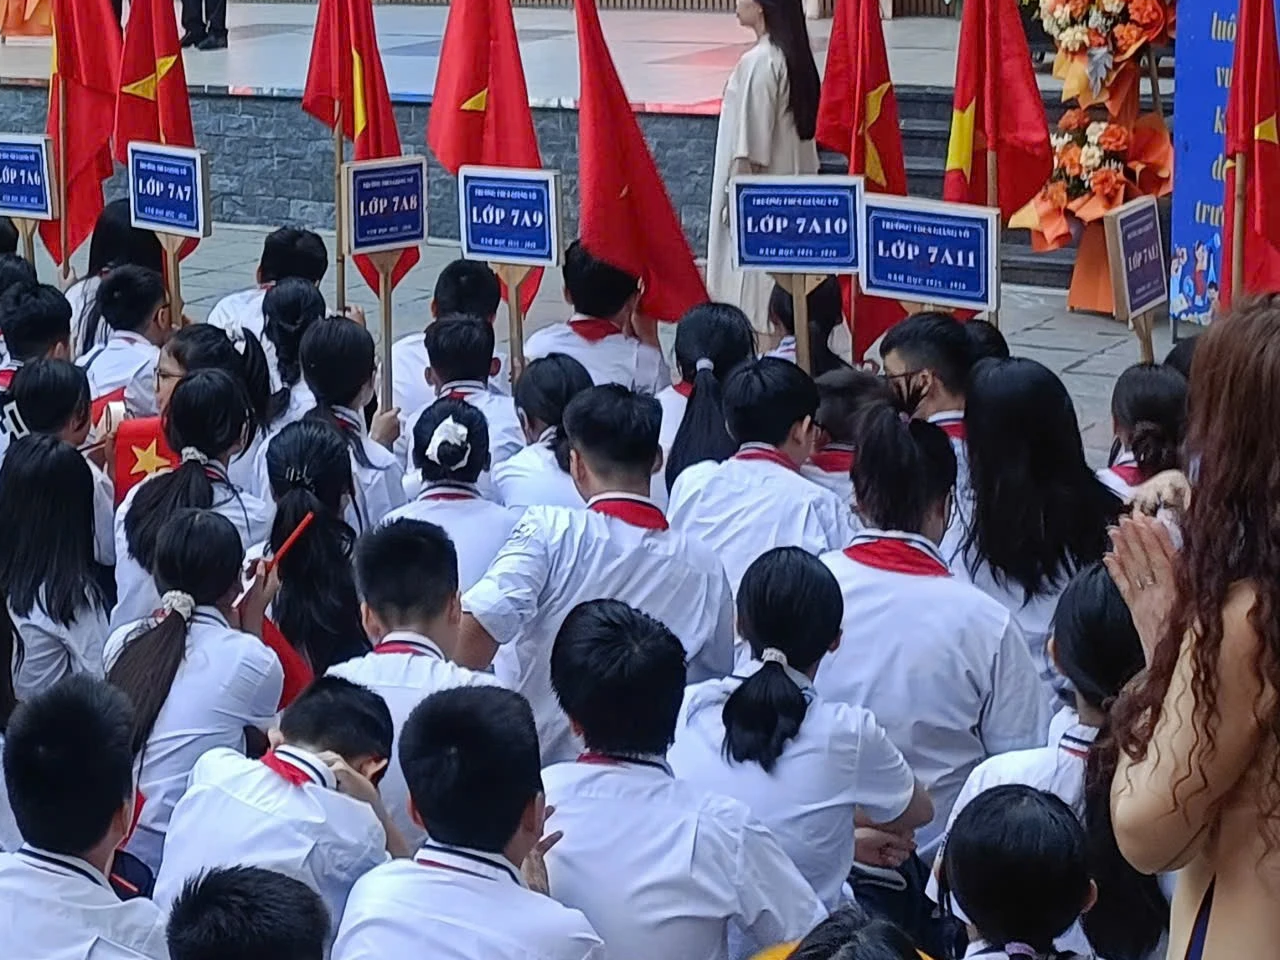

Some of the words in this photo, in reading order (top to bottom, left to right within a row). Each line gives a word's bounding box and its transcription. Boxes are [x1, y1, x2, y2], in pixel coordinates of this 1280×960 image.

[20, 169, 41, 186] 7A6
[138, 175, 164, 197] LỚP
[167, 182, 191, 202] 7A7
[360, 196, 388, 216] LỚP
[472, 203, 506, 225] LỚP
[511, 209, 543, 228] 7A9
[746, 213, 788, 234] LỚP
[796, 217, 848, 234] 7A10
[878, 239, 920, 260] LỚP
[927, 245, 975, 268] 7A11
